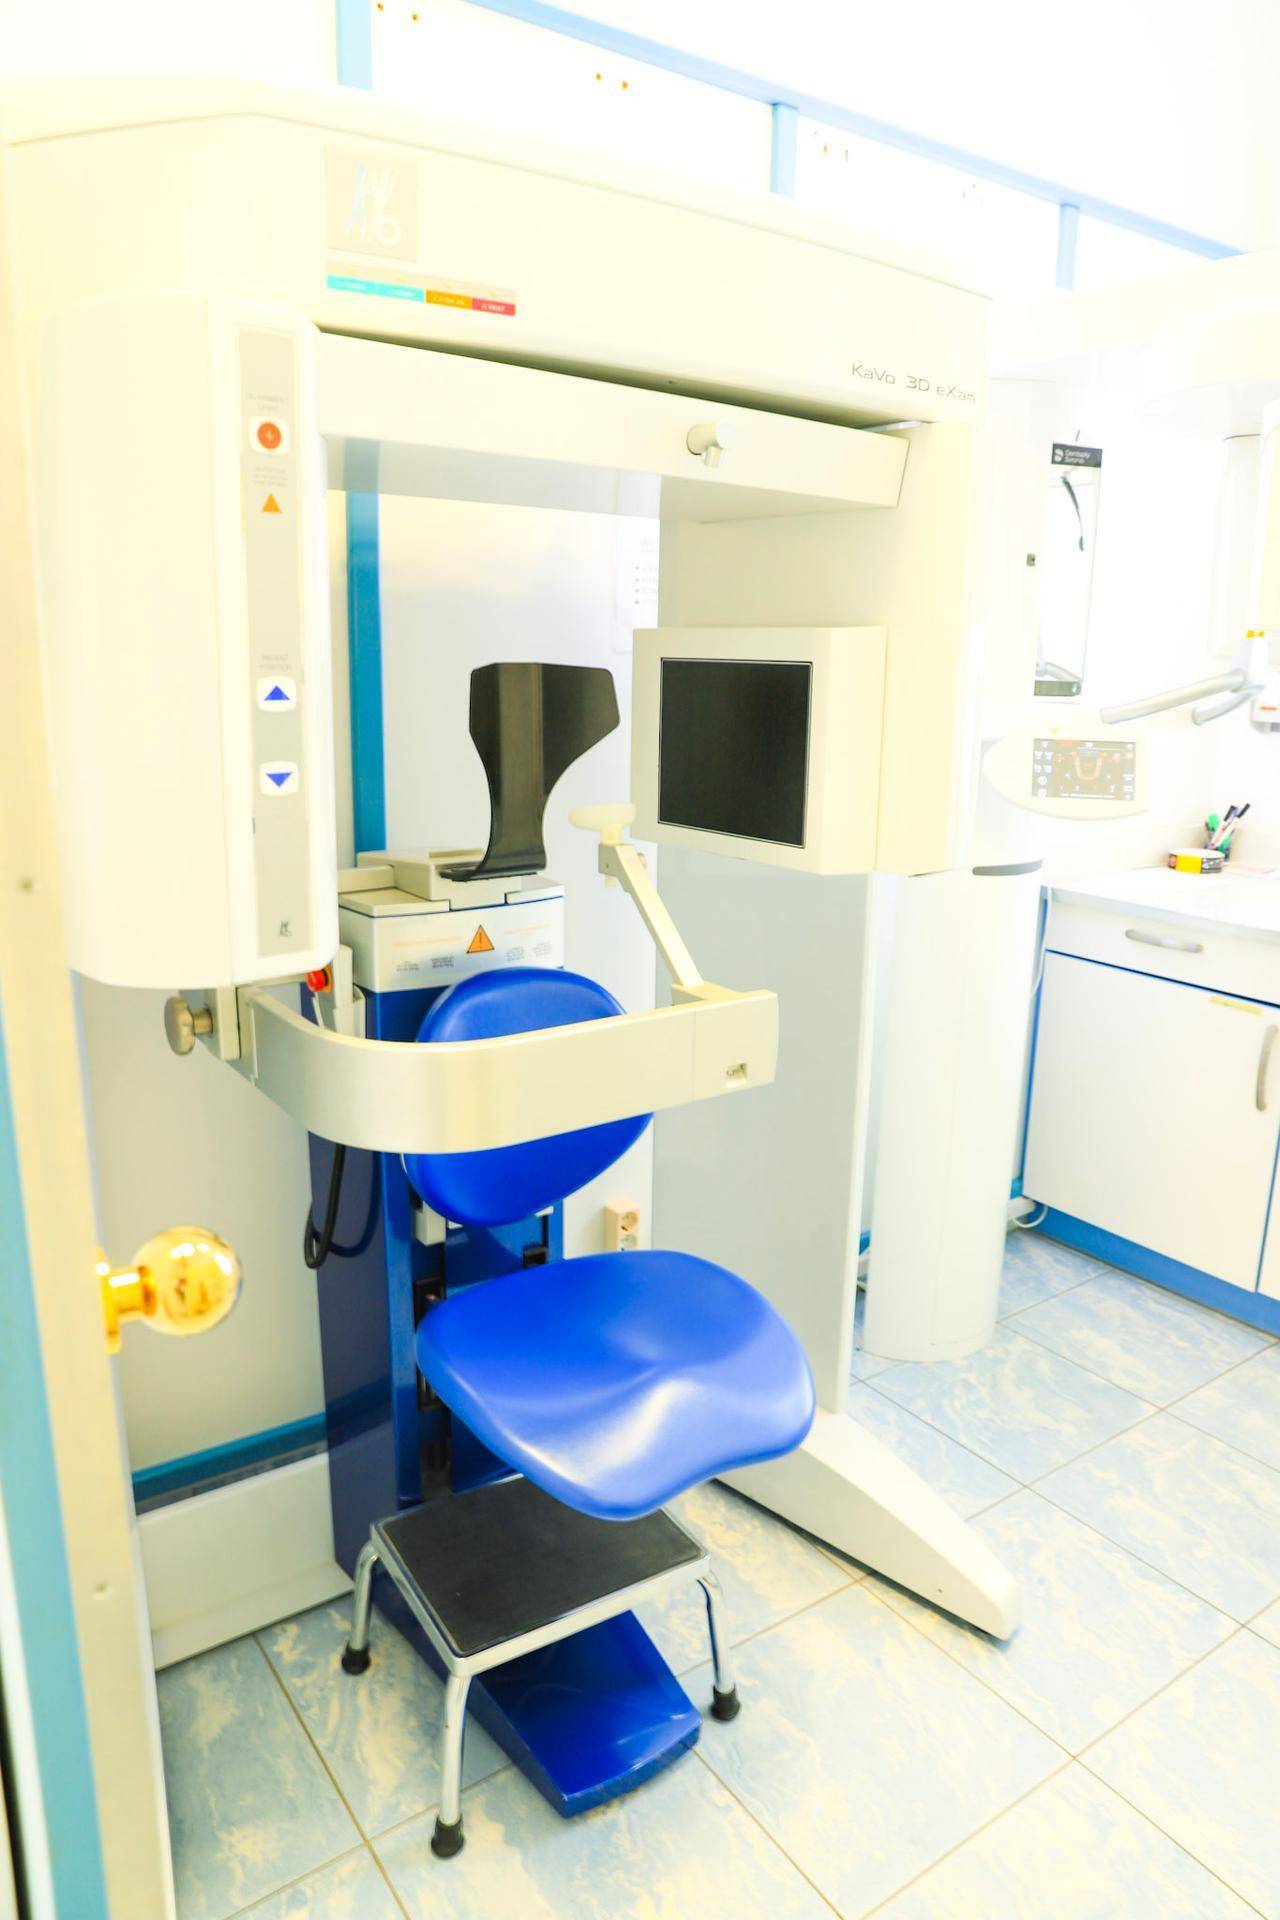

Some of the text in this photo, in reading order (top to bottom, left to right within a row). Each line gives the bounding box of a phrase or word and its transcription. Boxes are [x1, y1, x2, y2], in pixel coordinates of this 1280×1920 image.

[851, 362, 976, 403] KaVo 3D eXam
